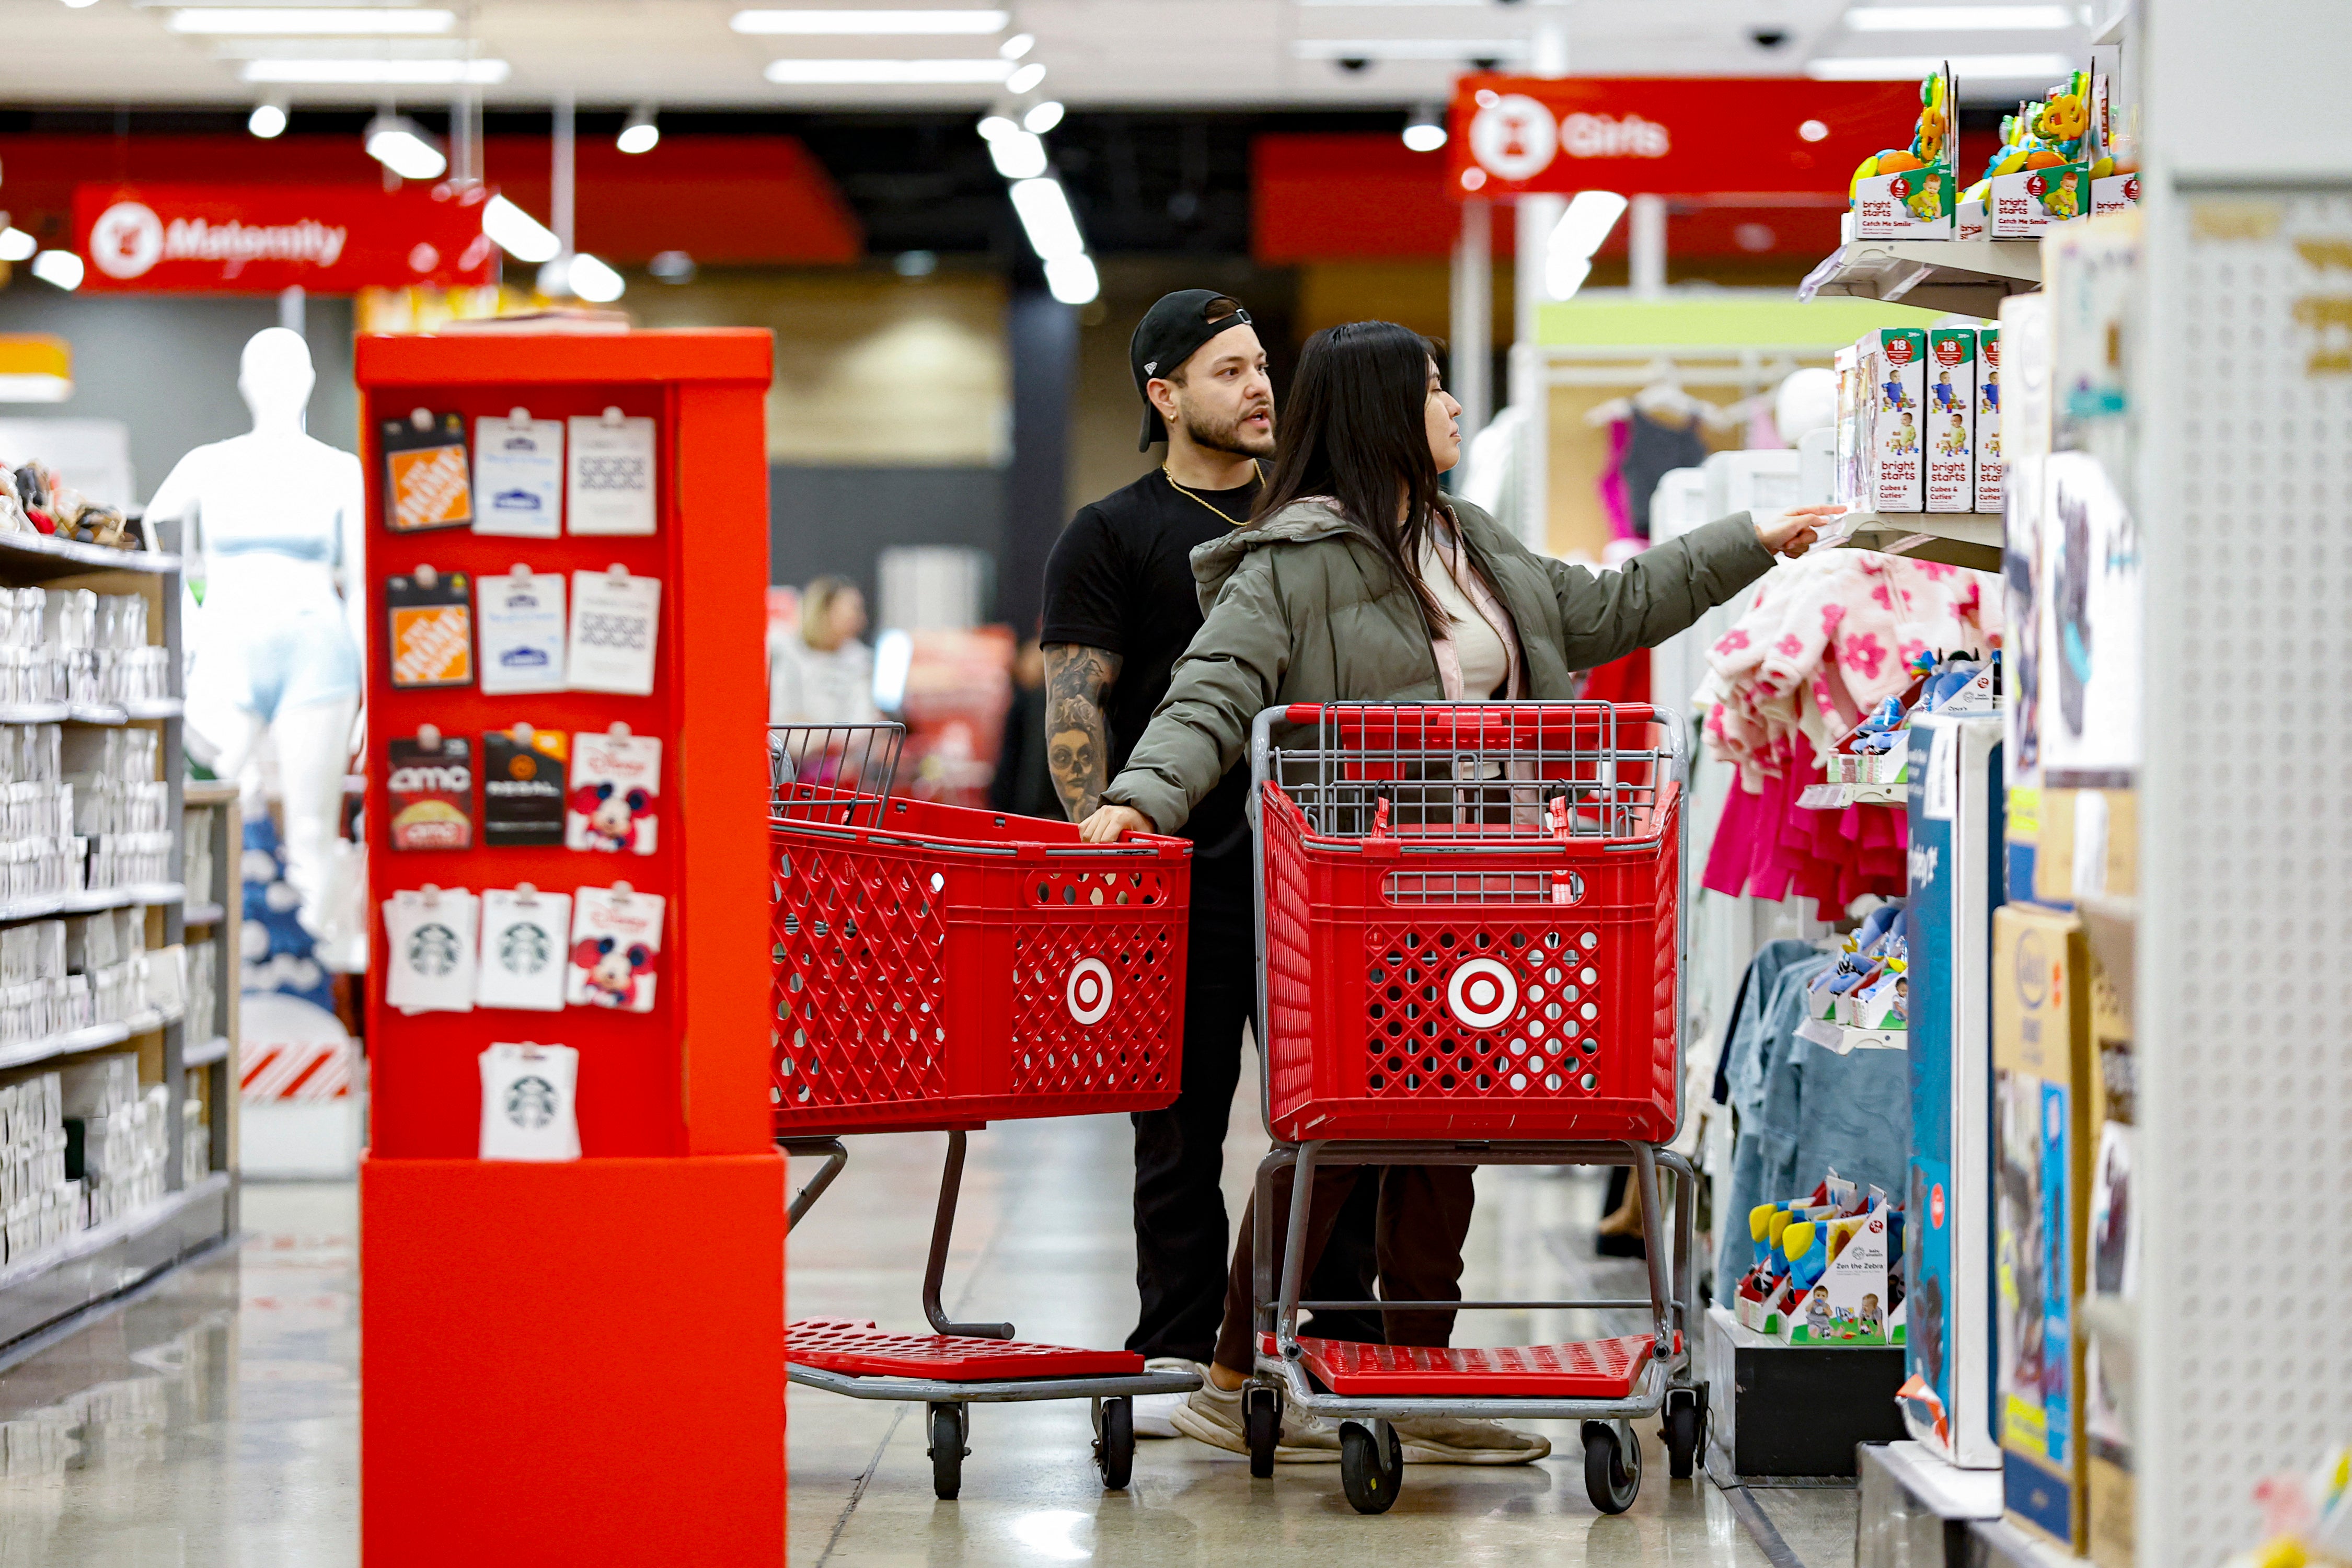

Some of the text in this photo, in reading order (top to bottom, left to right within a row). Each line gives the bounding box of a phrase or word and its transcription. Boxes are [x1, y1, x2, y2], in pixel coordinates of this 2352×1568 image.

[1561, 112, 1670, 158] Girls
[1895, 179, 1905, 189] 4
[2032, 177, 2041, 187] 4
[2129, 180, 2138, 190] 4
[1863, 201, 1891, 210] bright
[1999, 198, 2027, 207] bright
[2097, 202, 2124, 211] bright
[164, 217, 347, 268] Maternity
[1892, 340, 1907, 351] 18
[1941, 341, 1956, 352] 18
[1882, 461, 1915, 472] bright
[1932, 463, 1965, 474] bright
[1981, 463, 2002, 474] brig
[1932, 473, 1965, 481] starts
[388, 766, 470, 792] amc
